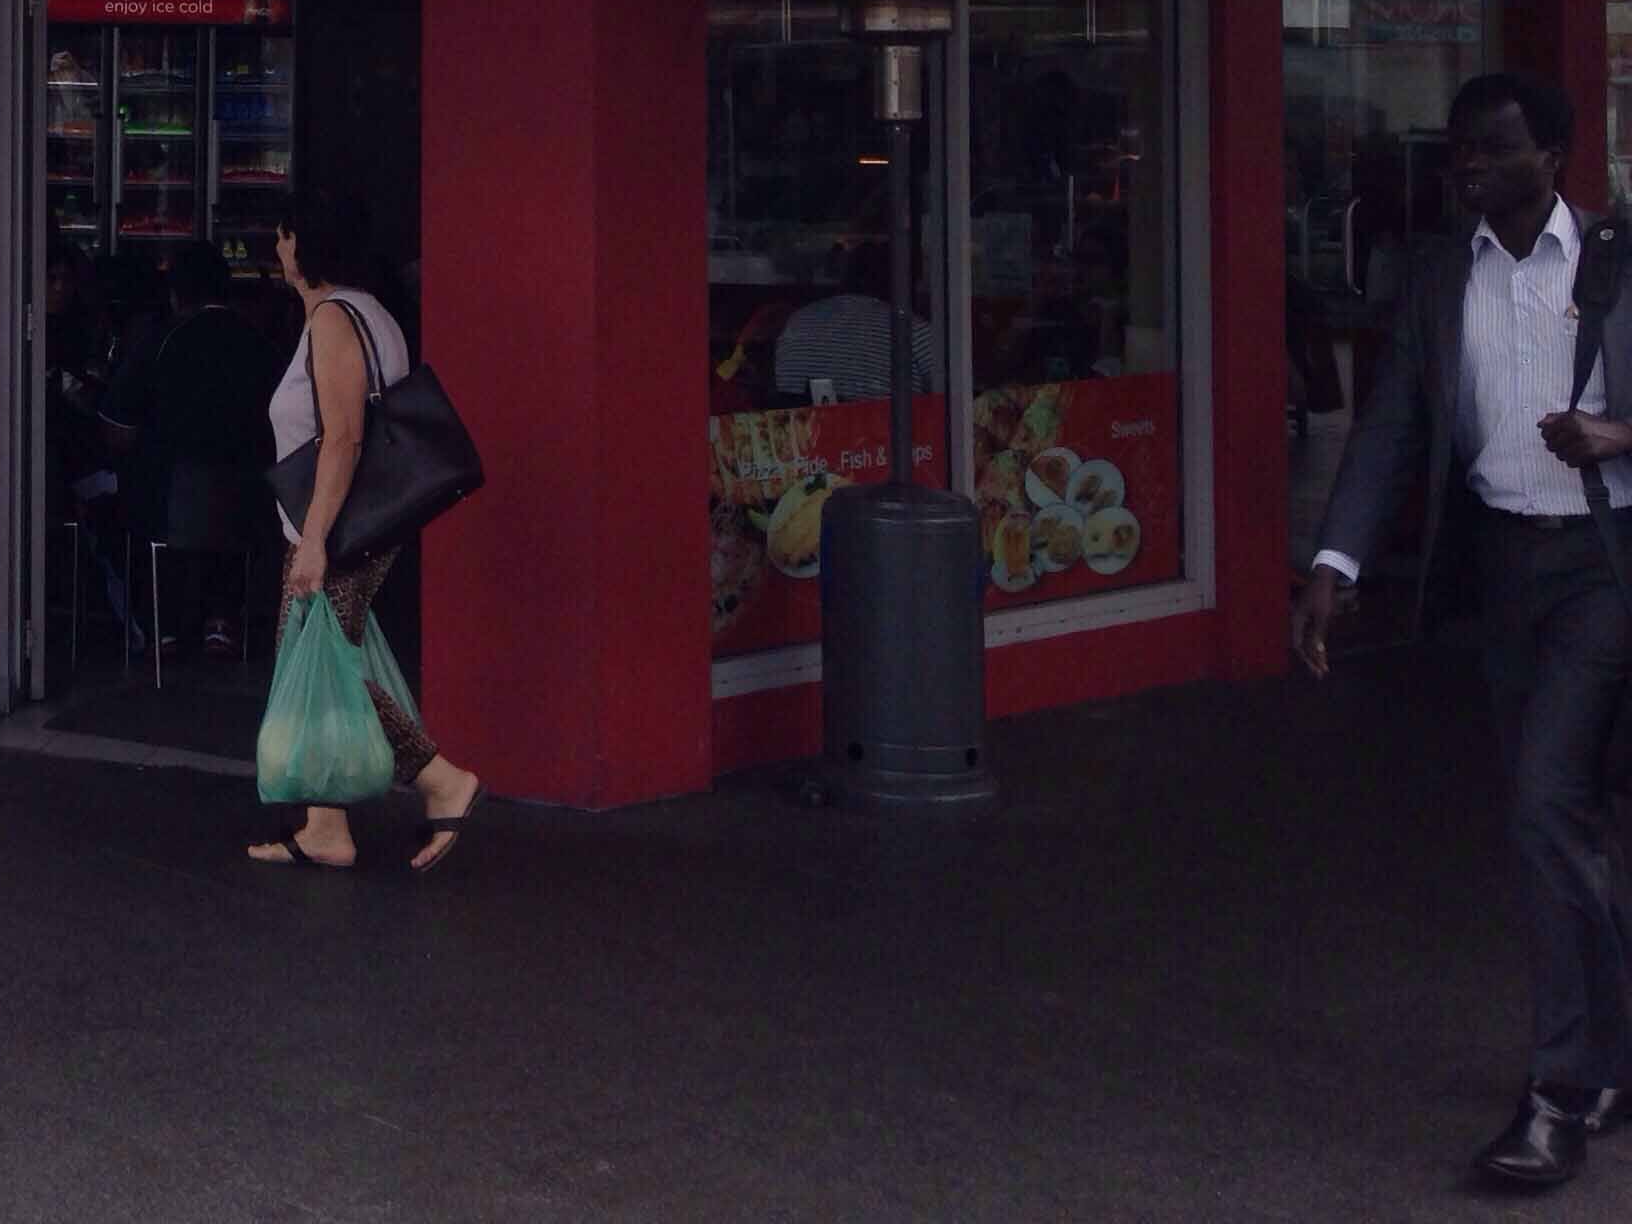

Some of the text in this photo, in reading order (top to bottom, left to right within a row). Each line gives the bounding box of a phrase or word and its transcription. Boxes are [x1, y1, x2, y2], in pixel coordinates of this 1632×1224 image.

[104, 0, 213, 15] enjoy ice cold
[841, 449, 872, 471] Fish
[876, 446, 888, 466] &
